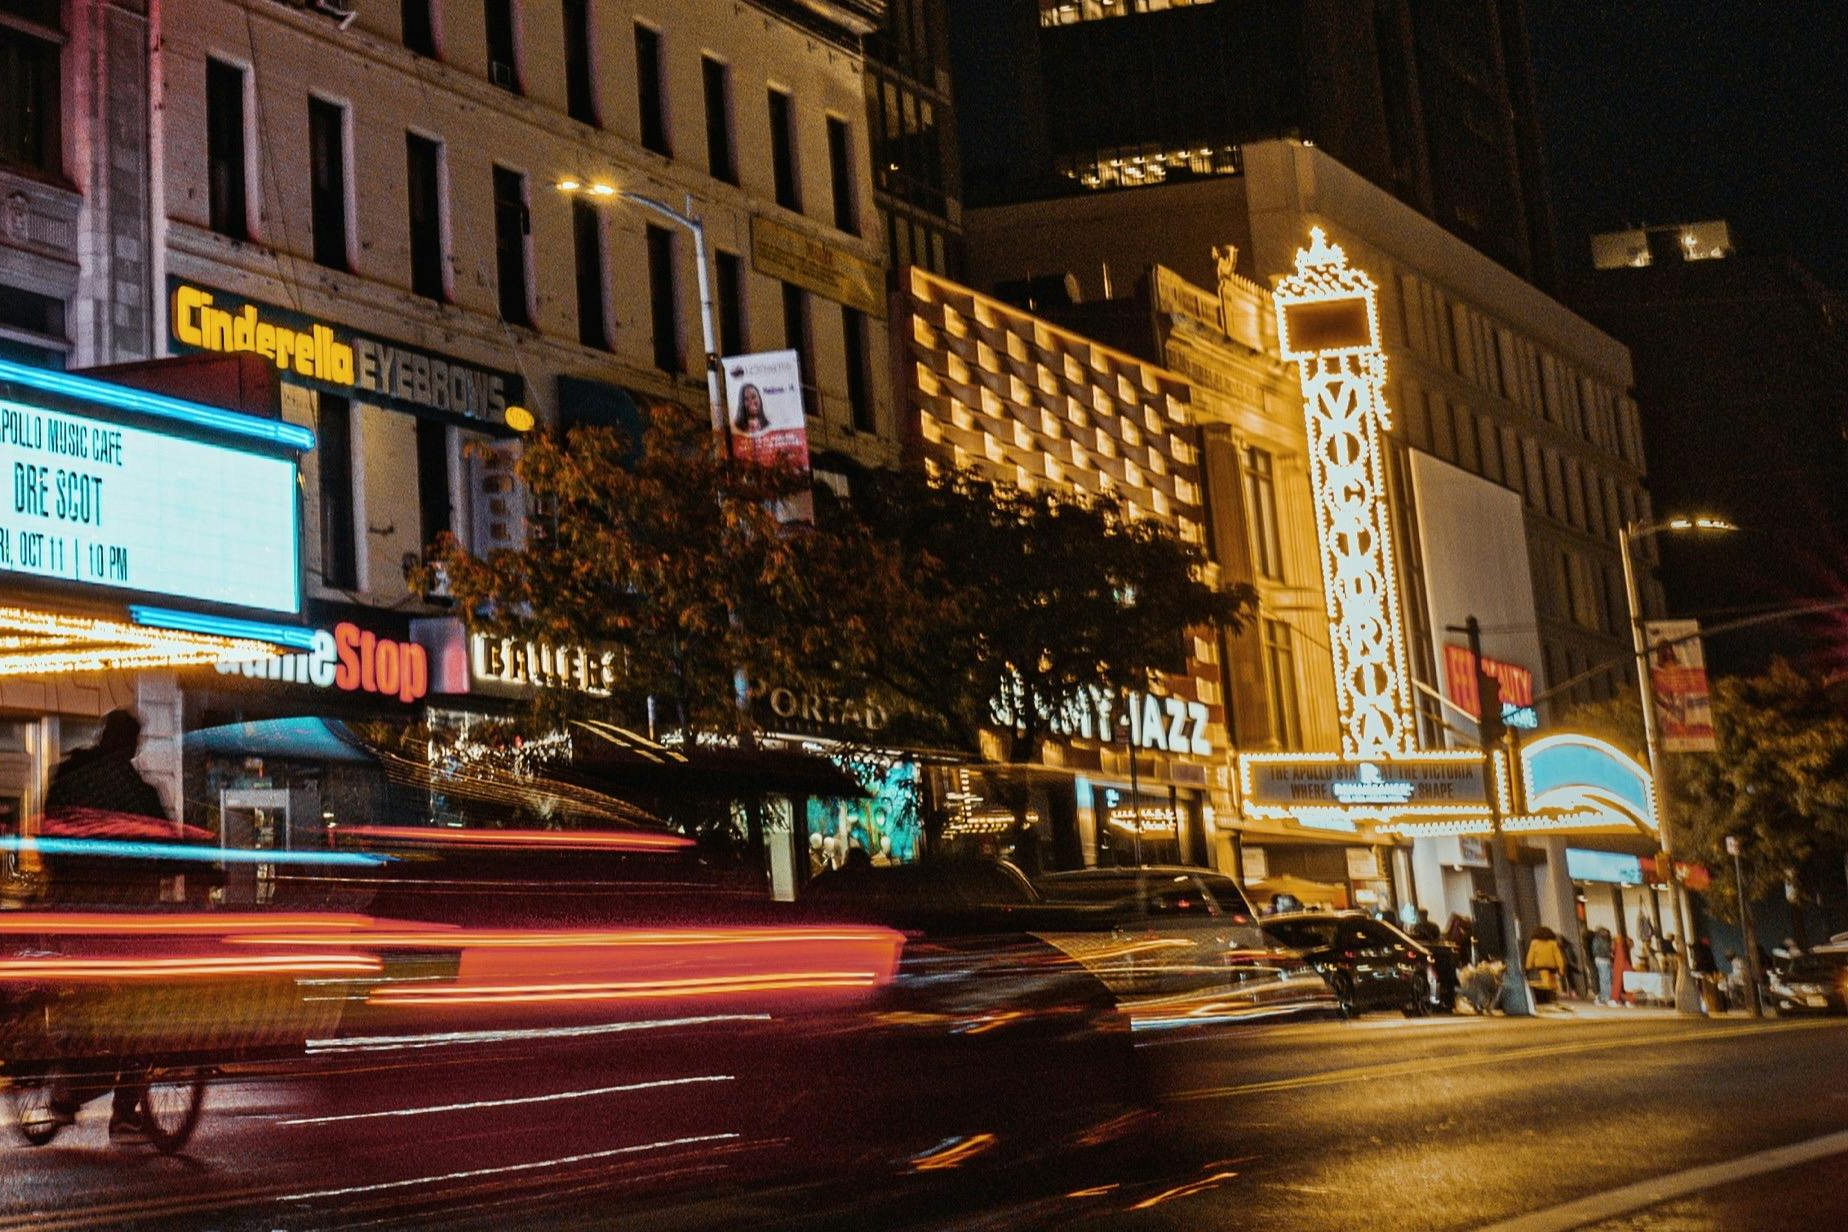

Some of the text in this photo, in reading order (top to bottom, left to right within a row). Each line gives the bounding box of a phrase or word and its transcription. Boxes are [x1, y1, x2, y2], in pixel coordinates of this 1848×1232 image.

[174, 285, 506, 424] Cinderella EYEBROWS
[48, 419, 88, 459] MUSIC
[14, 462, 103, 526] DRE SCOT
[19, 531, 46, 568] OCT
[50, 536, 64, 572] 11
[88, 543, 105, 577] 10
[110, 545, 128, 582] PM
[215, 623, 428, 704] ameStop
[1120, 690, 1212, 756] JAZZ
[1290, 783, 1327, 799] WHERE
[1293, 765, 1332, 780] APOLLO
